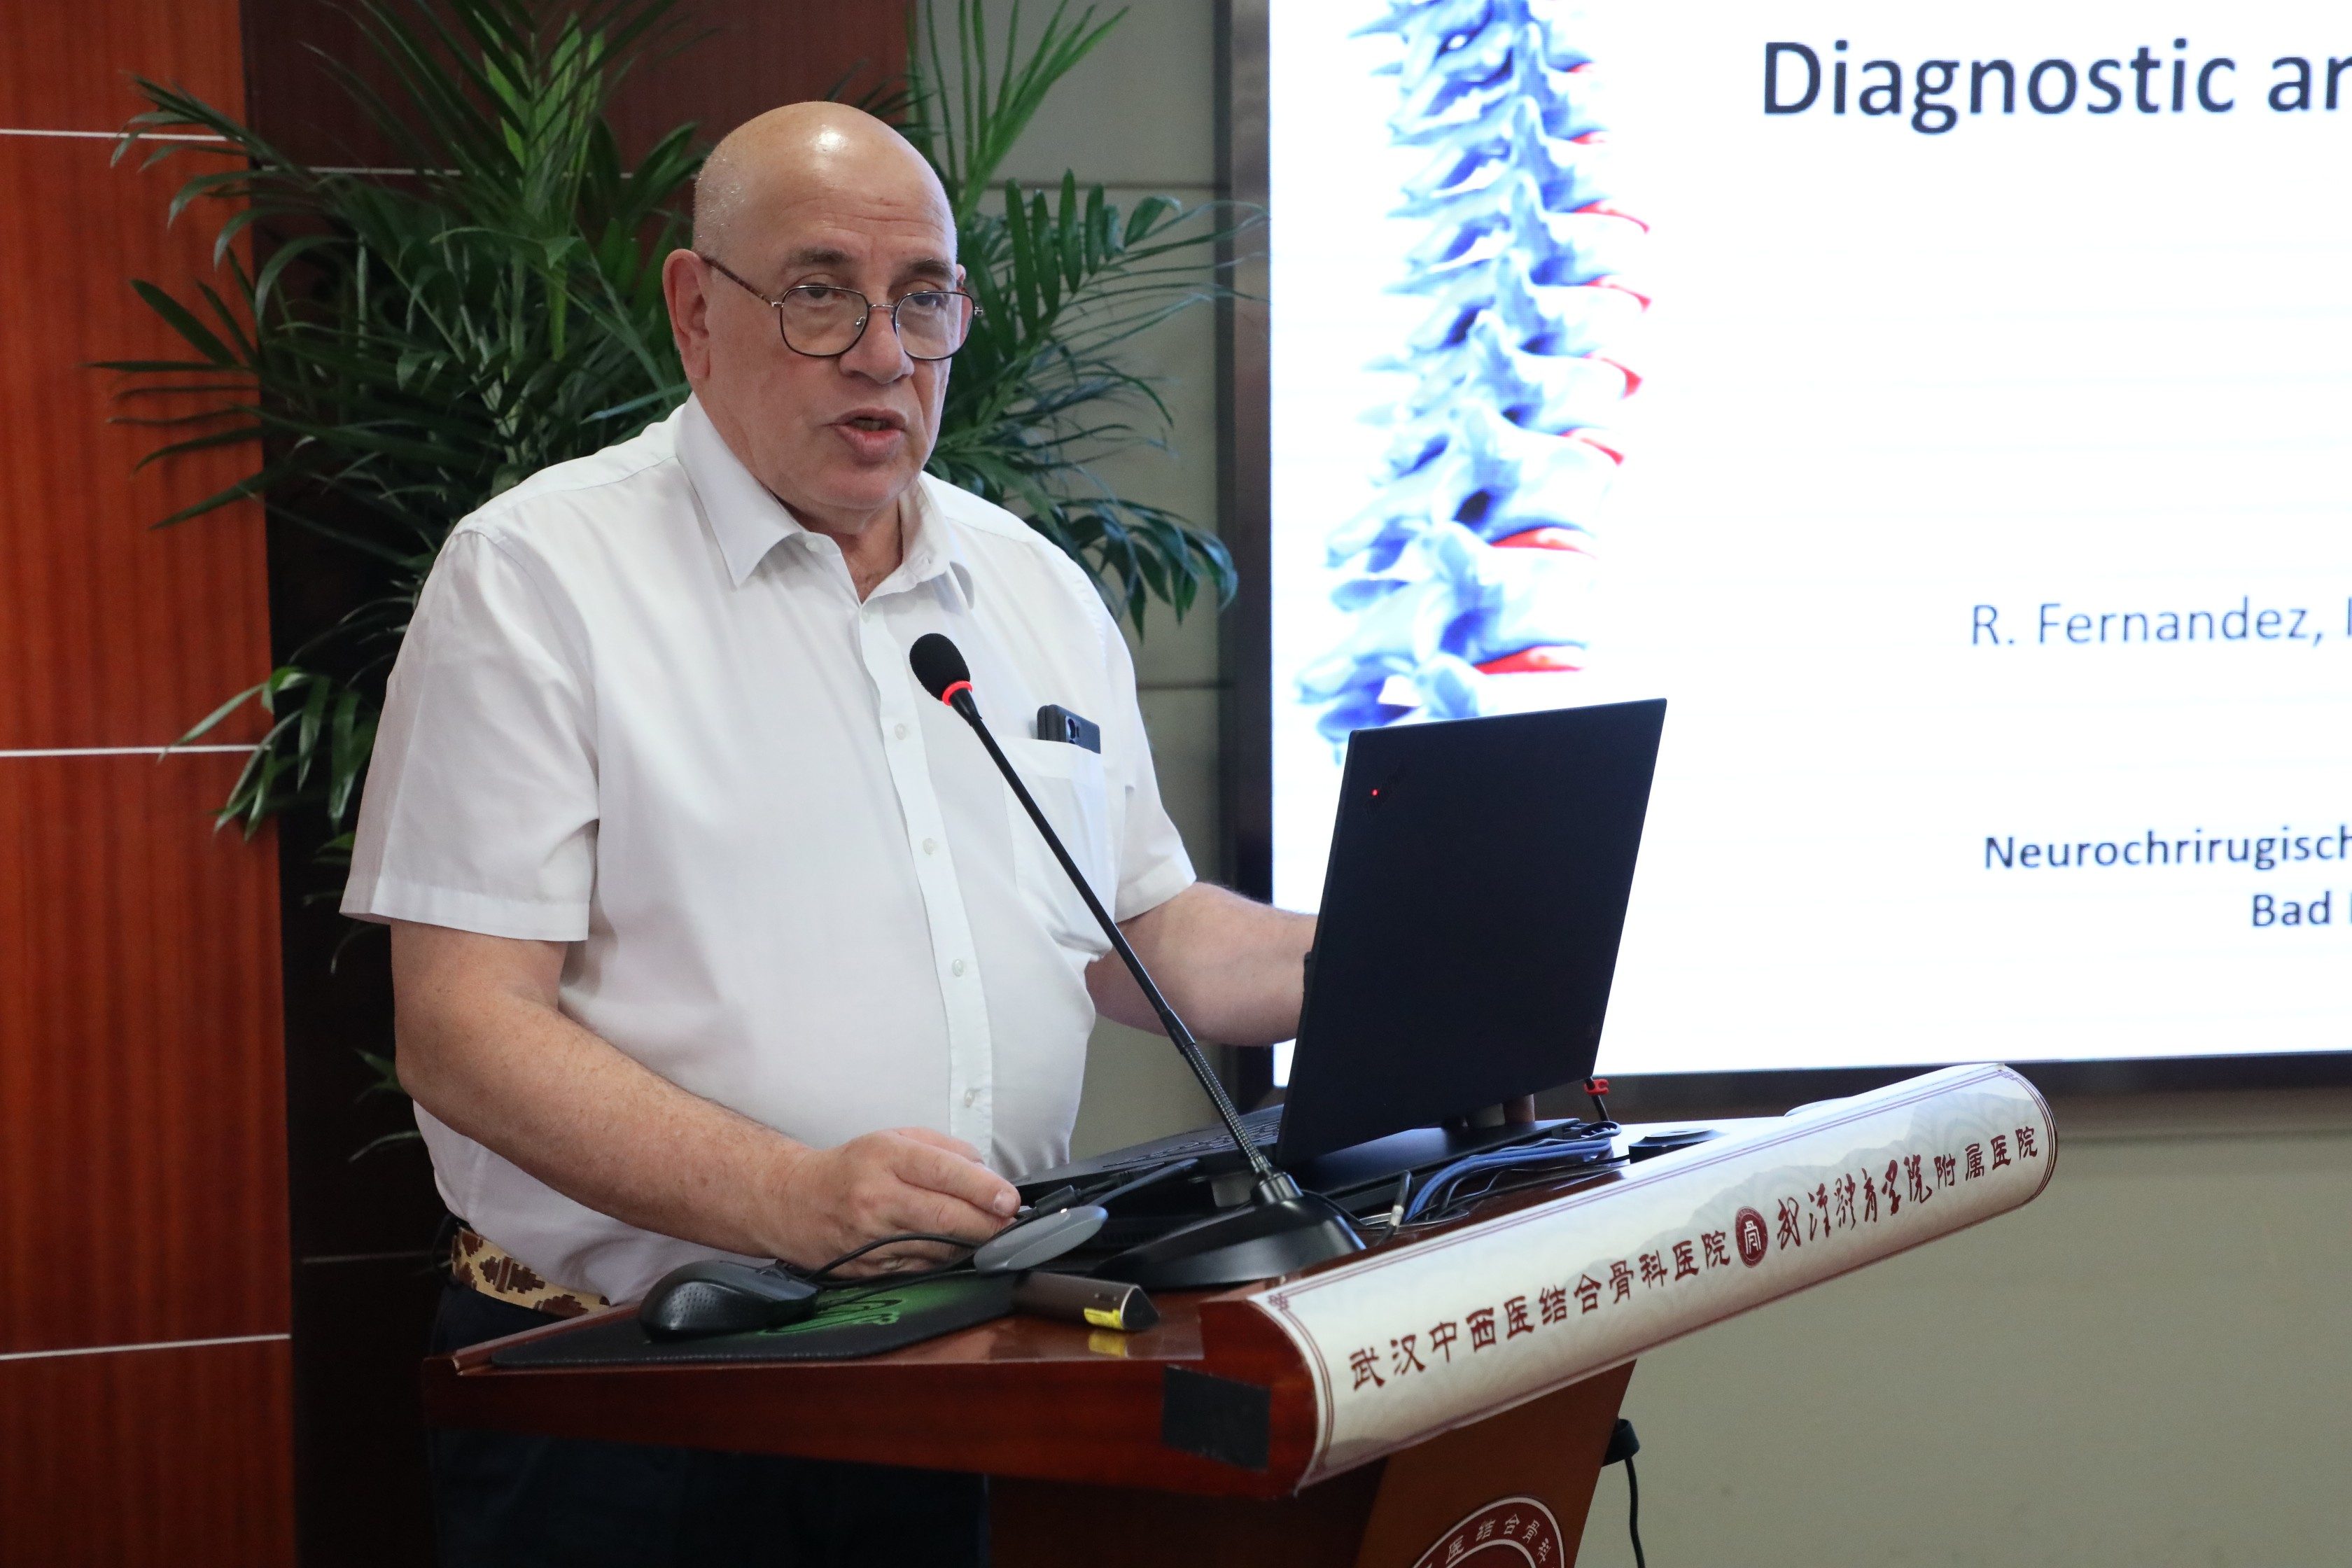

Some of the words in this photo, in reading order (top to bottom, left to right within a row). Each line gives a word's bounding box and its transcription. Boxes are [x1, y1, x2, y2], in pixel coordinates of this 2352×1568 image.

[1763, 38, 2237, 136] Diagnostic
[1972, 604, 2015, 645] R.
[2039, 595, 2323, 647] Fernandez,
[2252, 890, 2331, 927] Bad
[1349, 1230, 1731, 1391] 武汉中西医结合骨科医院
[1425, 1513, 1555, 1568] 医结合骨科
